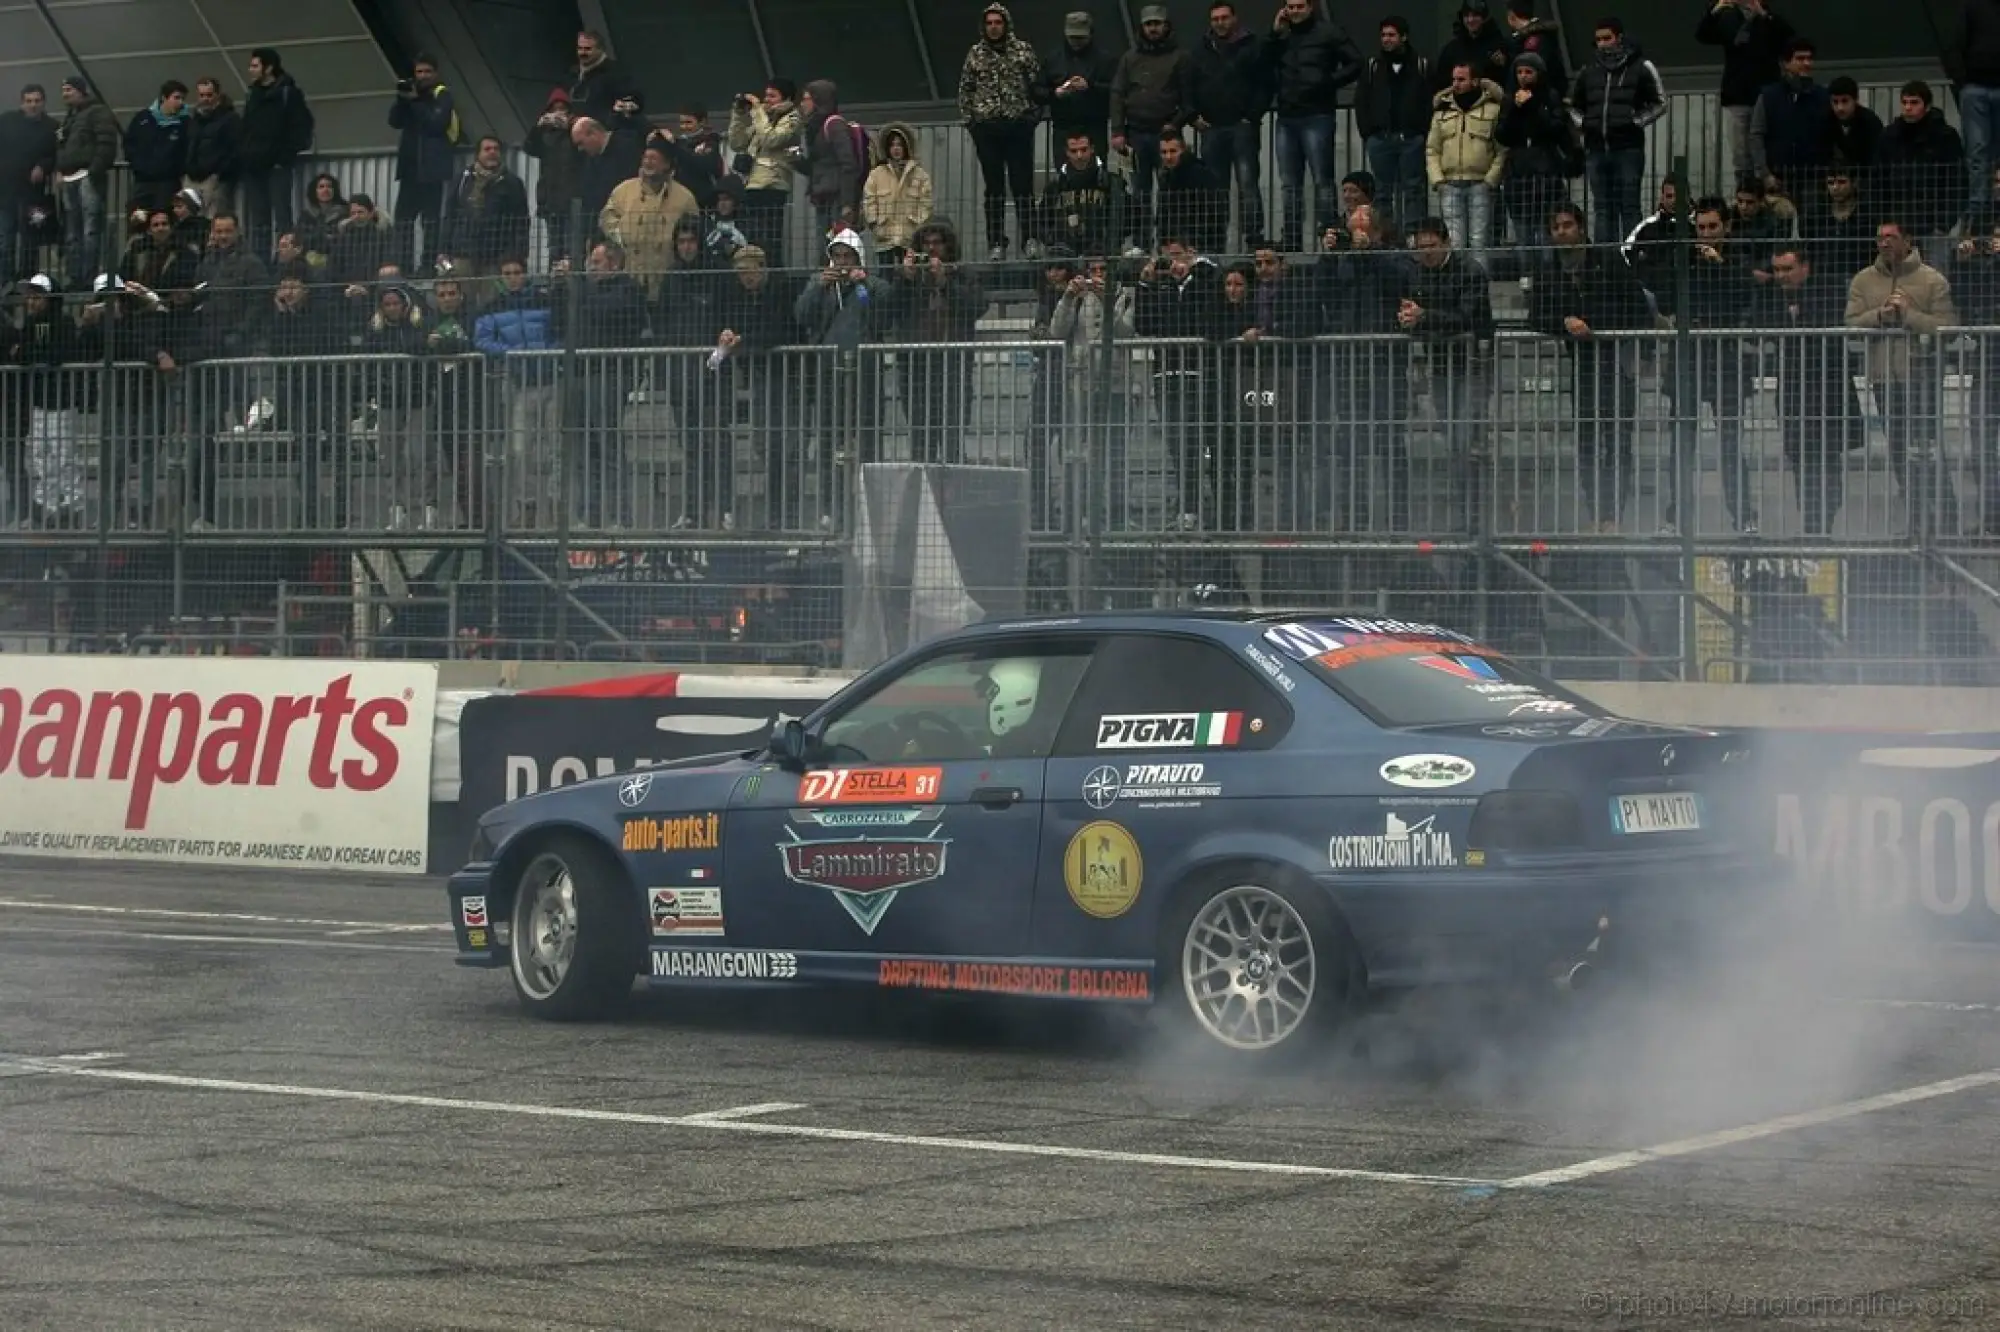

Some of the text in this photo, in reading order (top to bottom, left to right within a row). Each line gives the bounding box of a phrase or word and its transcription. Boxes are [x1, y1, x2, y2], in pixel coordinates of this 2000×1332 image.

[1099, 717, 1196, 743] PIGNA
[849, 772, 908, 789] STELLA
[915, 775, 938, 796] 31
[1126, 763, 1204, 785] PIMAUTO
[623, 812, 720, 853] auto-parts.it
[822, 813, 906, 825] CARROZZERIA
[42, 832, 91, 849] QUALITY
[92, 835, 177, 854] REPLACEMENT
[178, 839, 215, 857] PARTS
[216, 841, 242, 857] FOR
[242, 842, 305, 861] JAPANESE
[305, 844, 333, 862] AND
[334, 846, 387, 865] KOREAN
[387, 848, 422, 867] CARS
[798, 845, 938, 878] Lammirato
[652, 951, 769, 978] MARANGONI
[878, 959, 1149, 999] DRIFTING MOTORSPORT BOLOGNA
